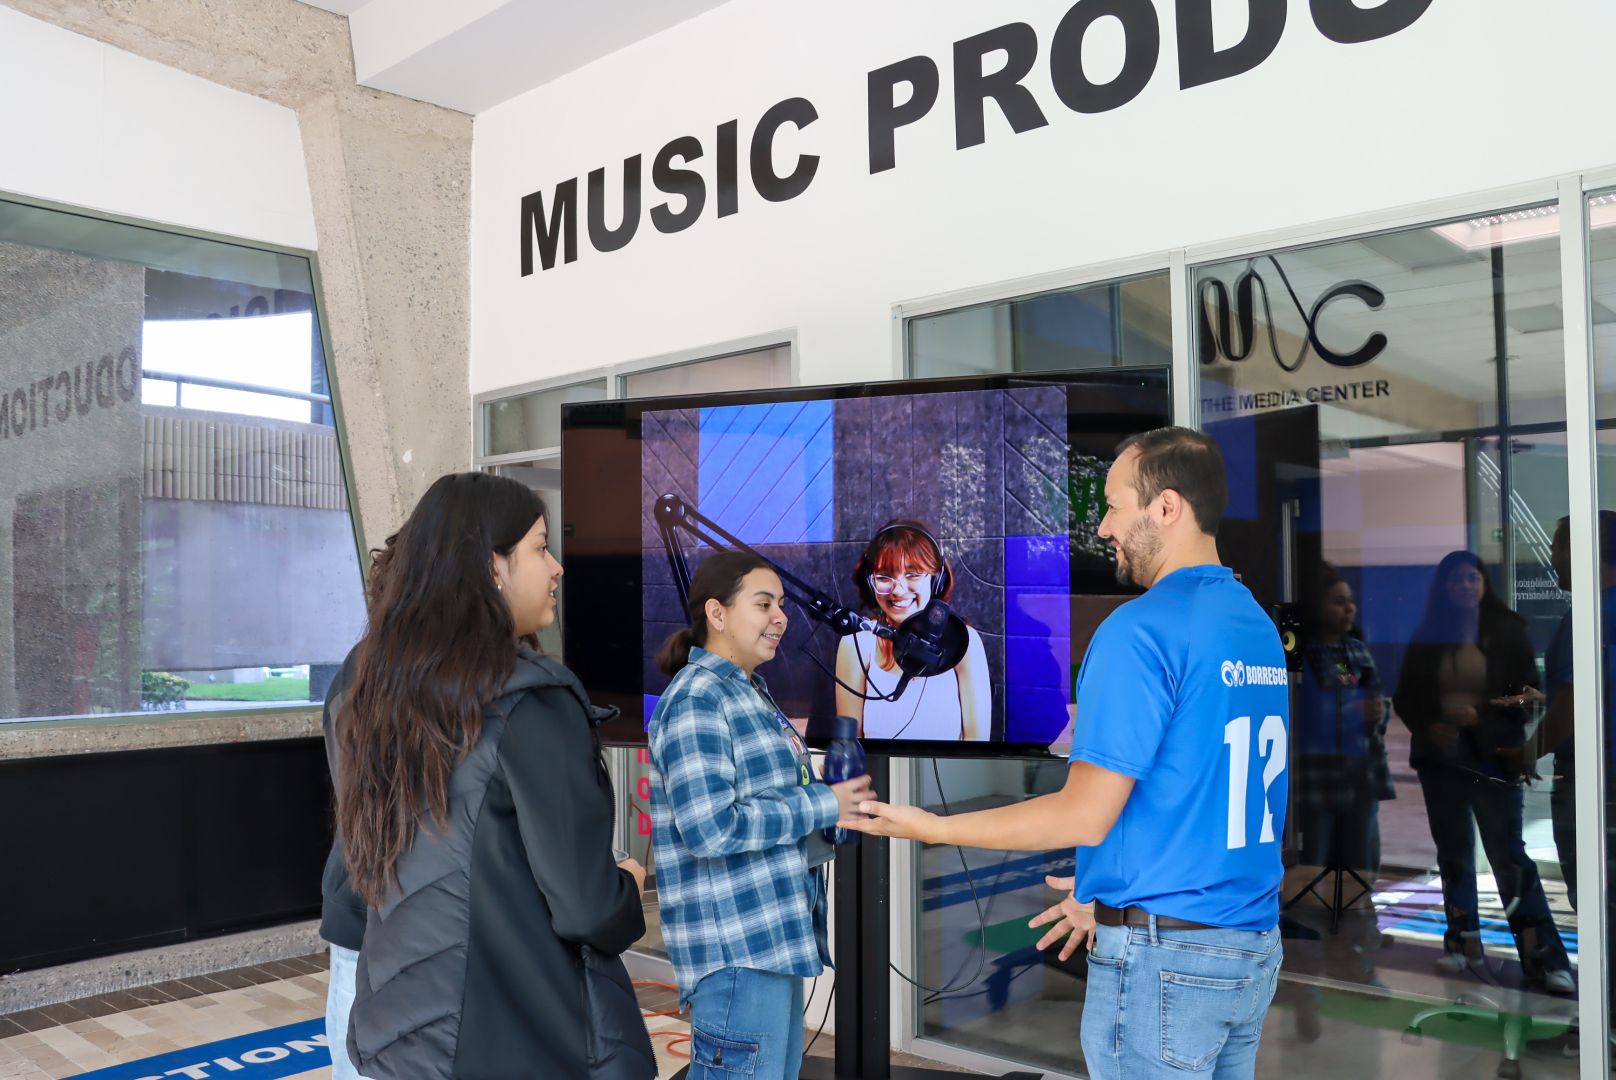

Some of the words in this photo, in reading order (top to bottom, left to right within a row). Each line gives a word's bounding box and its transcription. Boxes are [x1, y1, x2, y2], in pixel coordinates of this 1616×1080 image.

[521, 97, 820, 277] MUSIC
[1201, 397, 1234, 413] THE
[1239, 390, 1301, 409] MEDIA
[1306, 380, 1390, 402] CENTER
[1246, 665, 1288, 686] BORREGOS
[1224, 715, 1287, 849] 12
[134, 1034, 329, 1080] TION
